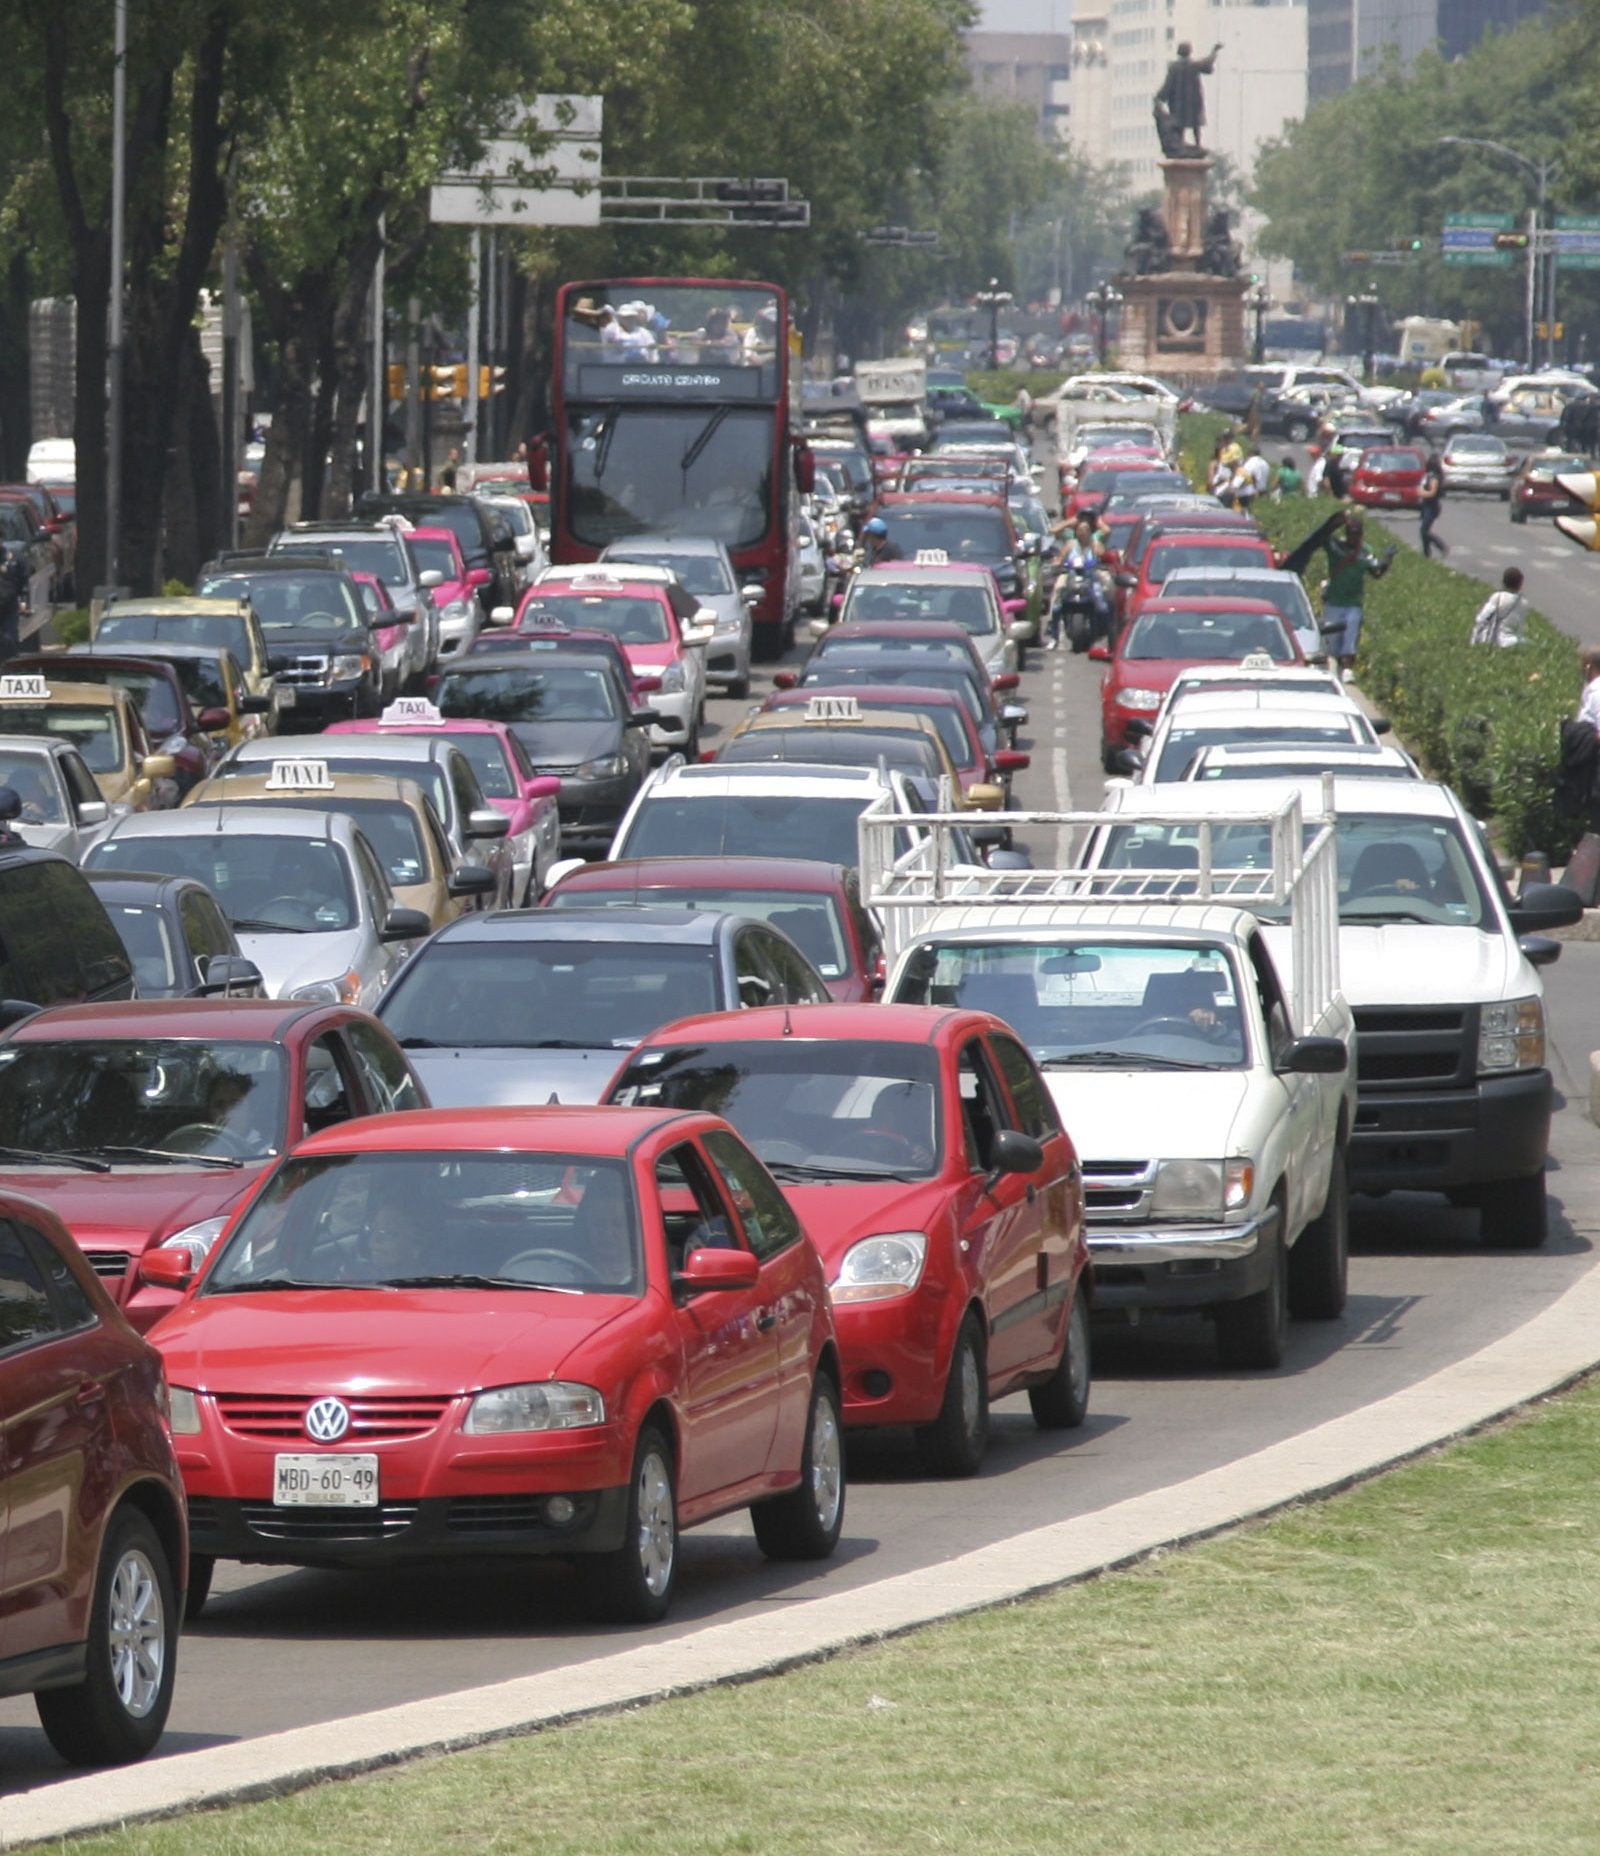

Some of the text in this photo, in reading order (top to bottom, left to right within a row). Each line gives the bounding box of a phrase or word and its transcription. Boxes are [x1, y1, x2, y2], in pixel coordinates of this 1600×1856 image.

[4, 679, 41, 694] TAXI
[398, 701, 426, 714] TAXI
[813, 700, 853, 716] TAXI
[276, 765, 323, 784] TAXI
[278, 1468, 374, 1491] MBD-60-49
